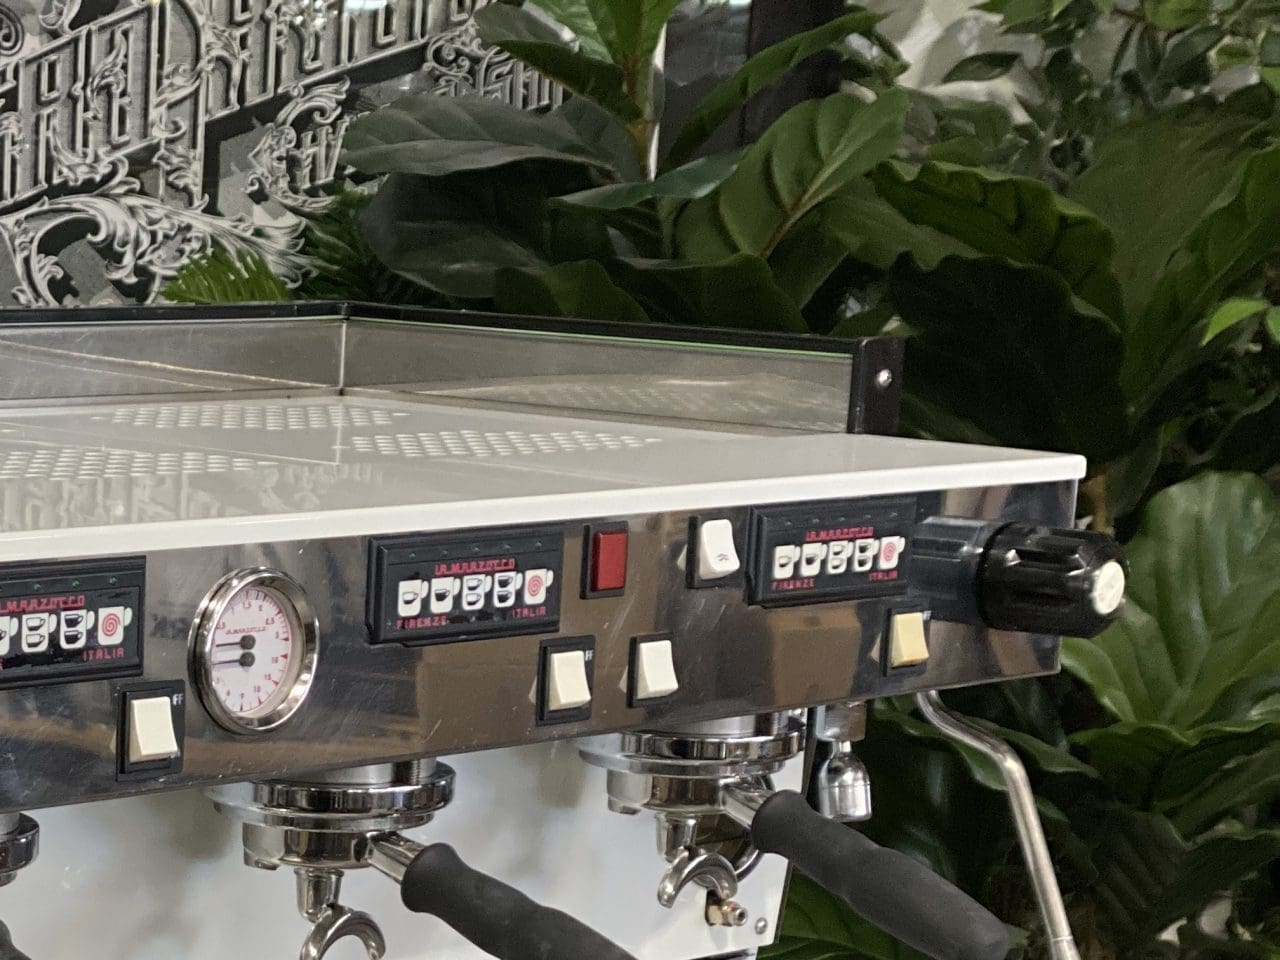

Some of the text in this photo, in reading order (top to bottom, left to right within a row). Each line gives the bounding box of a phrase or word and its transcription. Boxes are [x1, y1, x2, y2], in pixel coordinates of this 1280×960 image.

[868, 569, 899, 582] ITALIA
[770, 578, 816, 591] FIRENZE
[511, 606, 547, 619] ITALIA
[395, 613, 449, 631] FIRENZE
[83, 646, 125, 662] ITALIA
